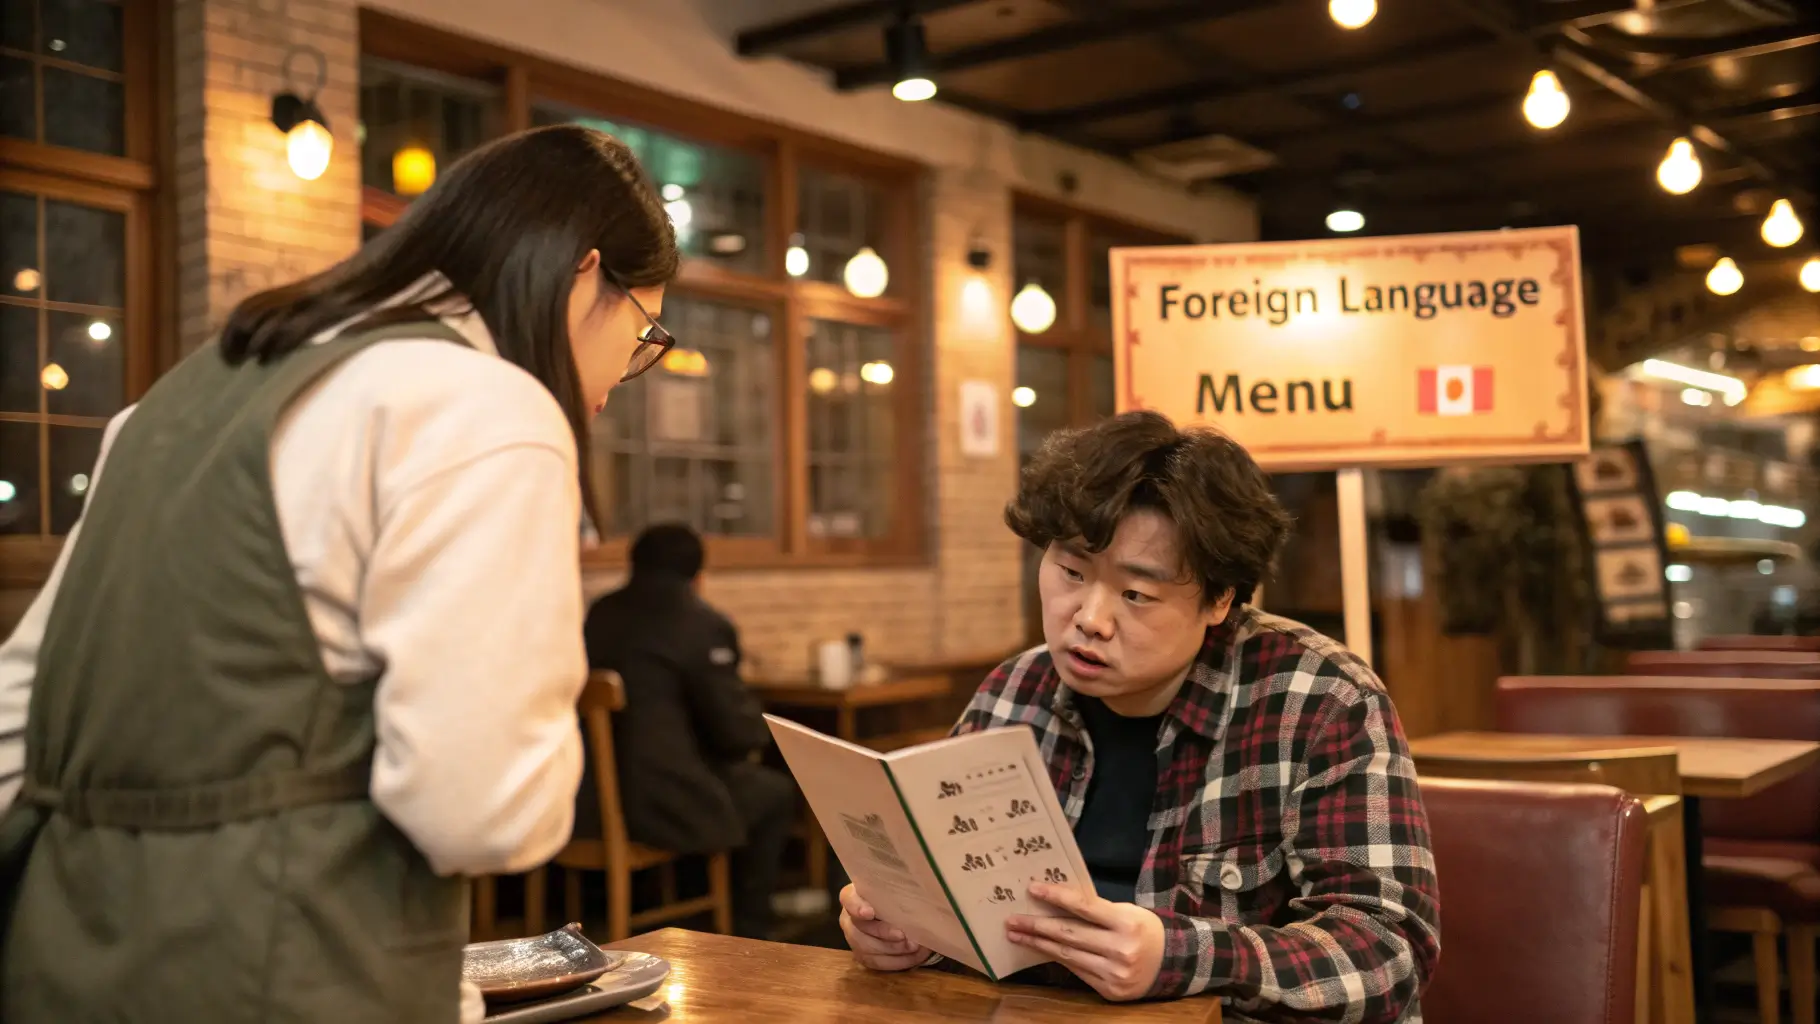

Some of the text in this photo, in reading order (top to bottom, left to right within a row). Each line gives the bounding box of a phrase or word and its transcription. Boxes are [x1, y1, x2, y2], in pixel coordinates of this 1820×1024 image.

[1160, 277, 1540, 324] Foreign Language
[1196, 373, 1353, 414] Menu
